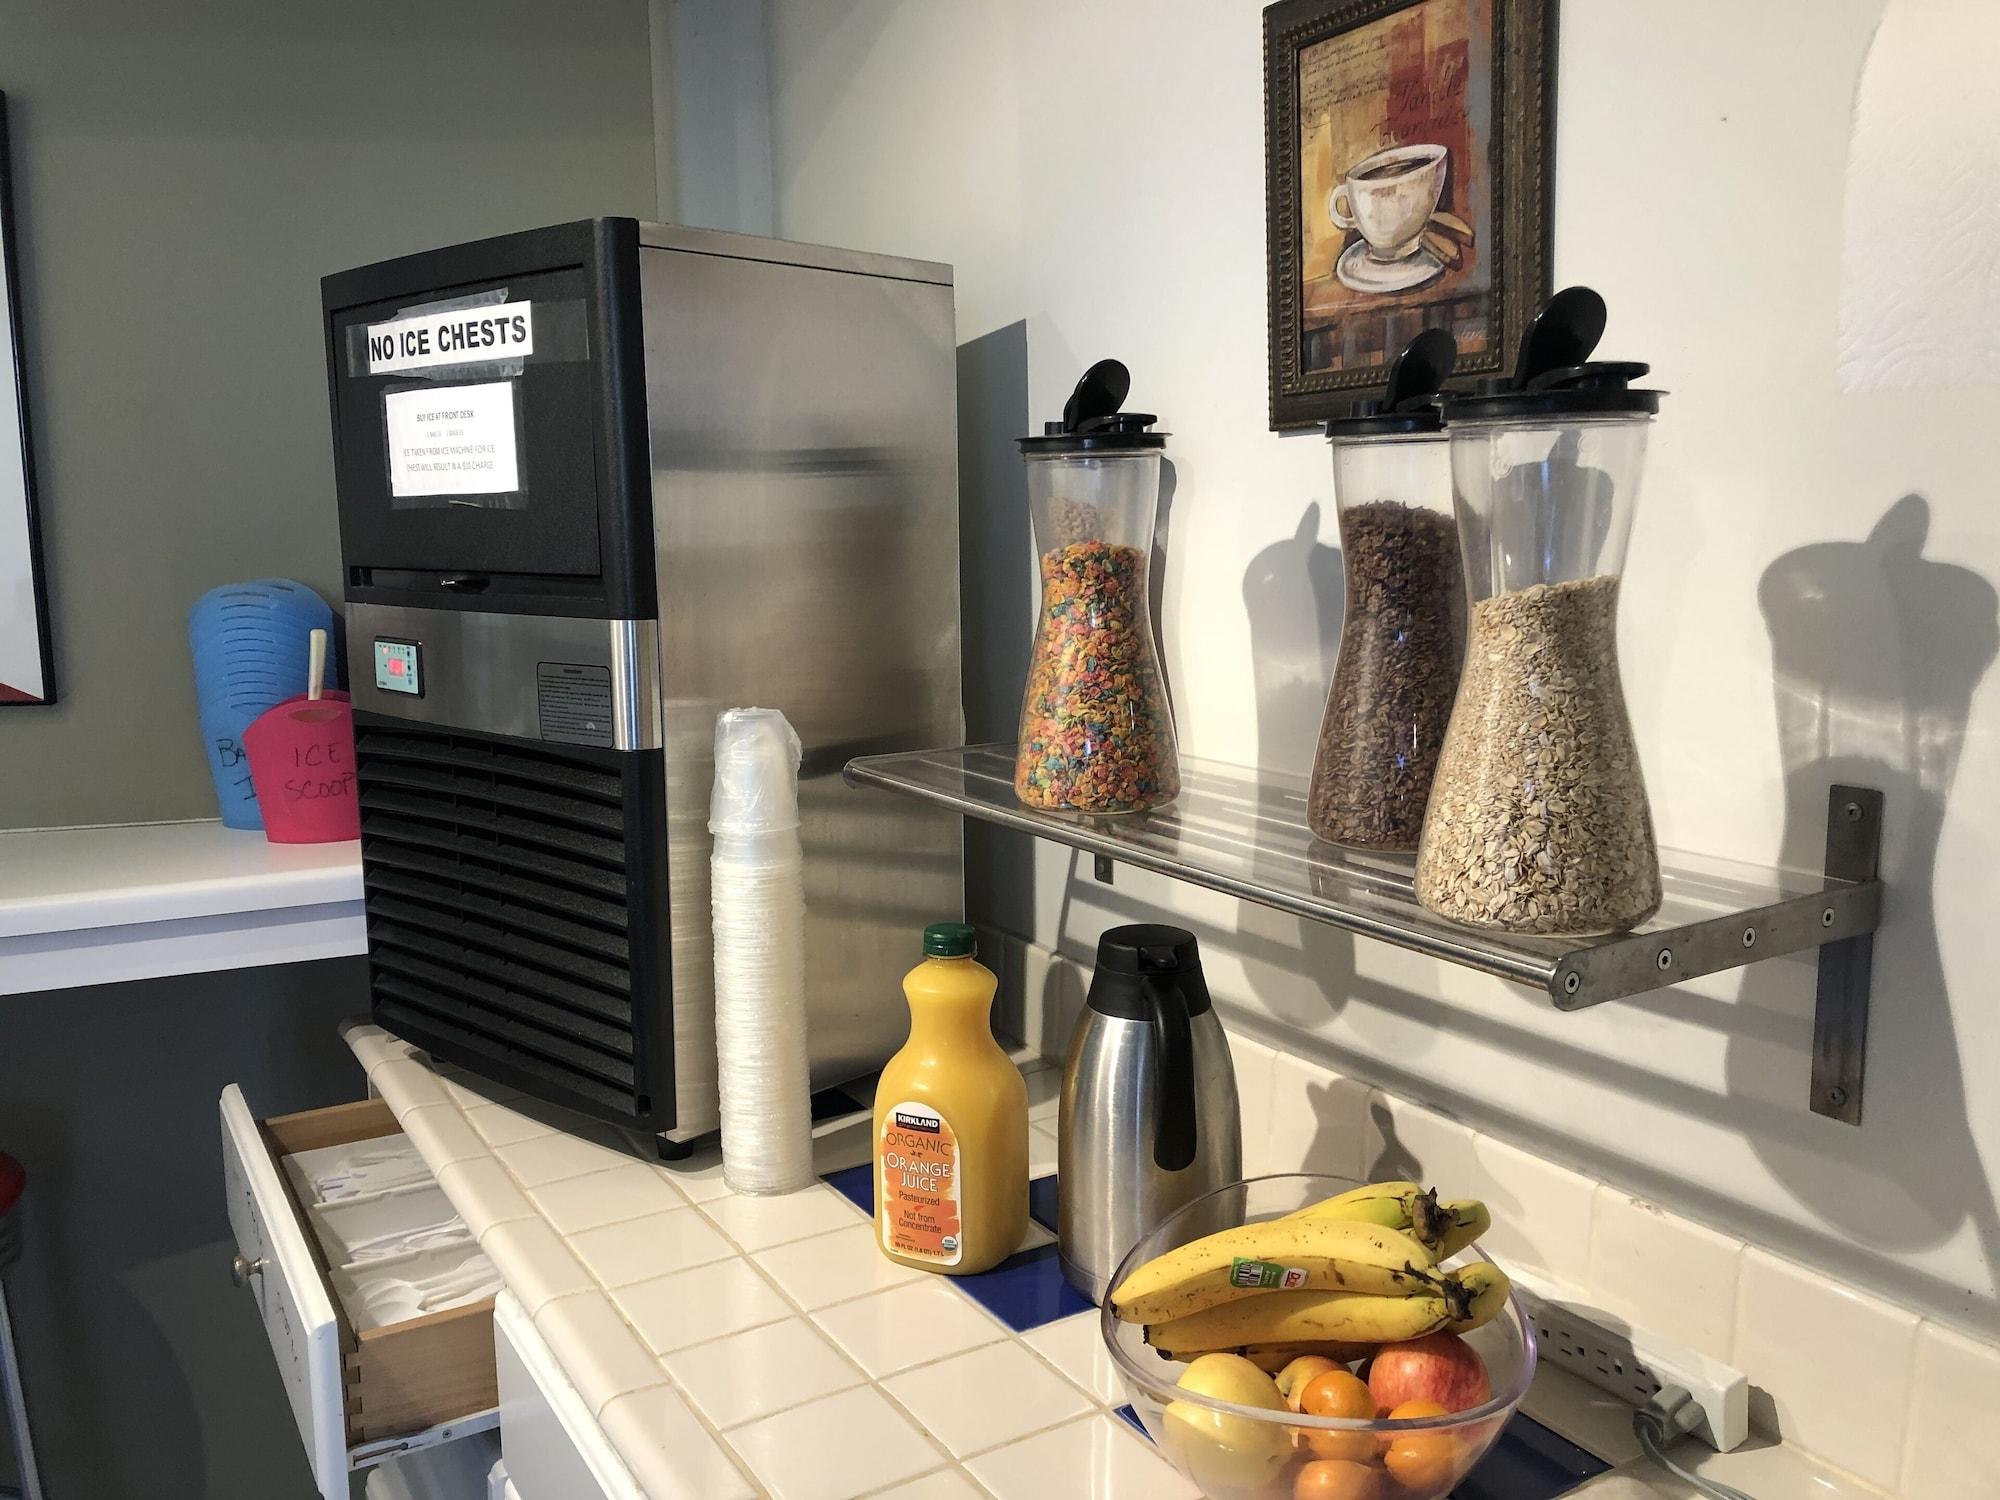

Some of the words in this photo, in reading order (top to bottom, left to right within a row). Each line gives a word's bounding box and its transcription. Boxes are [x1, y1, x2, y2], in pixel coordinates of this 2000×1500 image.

[370, 335, 394, 362] NO
[399, 329, 431, 358] ICE
[438, 315, 527, 352] CHESTS
[416, 413, 426, 422] BUY
[427, 413, 435, 421] ICE
[435, 412, 441, 420] AT
[442, 410, 459, 420] FRONT
[460, 410, 475, 419] DESK
[411, 448, 425, 456] TAKEN
[426, 447, 440, 456] FROM
[441, 447, 449, 455] ICE
[450, 445, 473, 455] MACHINE
[475, 445, 486, 454] FOR
[407, 463, 420, 472] CHEST
[420, 463, 432, 471] WILL
[433, 462, 450, 471] RESULT
[472, 460, 494, 470] CHARGE
[294, 742, 343, 769] ICE
[285, 772, 356, 801] SCOOP
[897, 1113, 939, 1128] KIRKLAND
[886, 1132, 952, 1156] ORGANIC
[887, 1152, 950, 1178] ORANGE
[901, 1171, 938, 1192] JUICE
[898, 1190, 940, 1206] Pasteurized
[903, 1209, 916, 1221] Not
[917, 1212, 935, 1224] from
[898, 1217, 942, 1233] Concentrate
